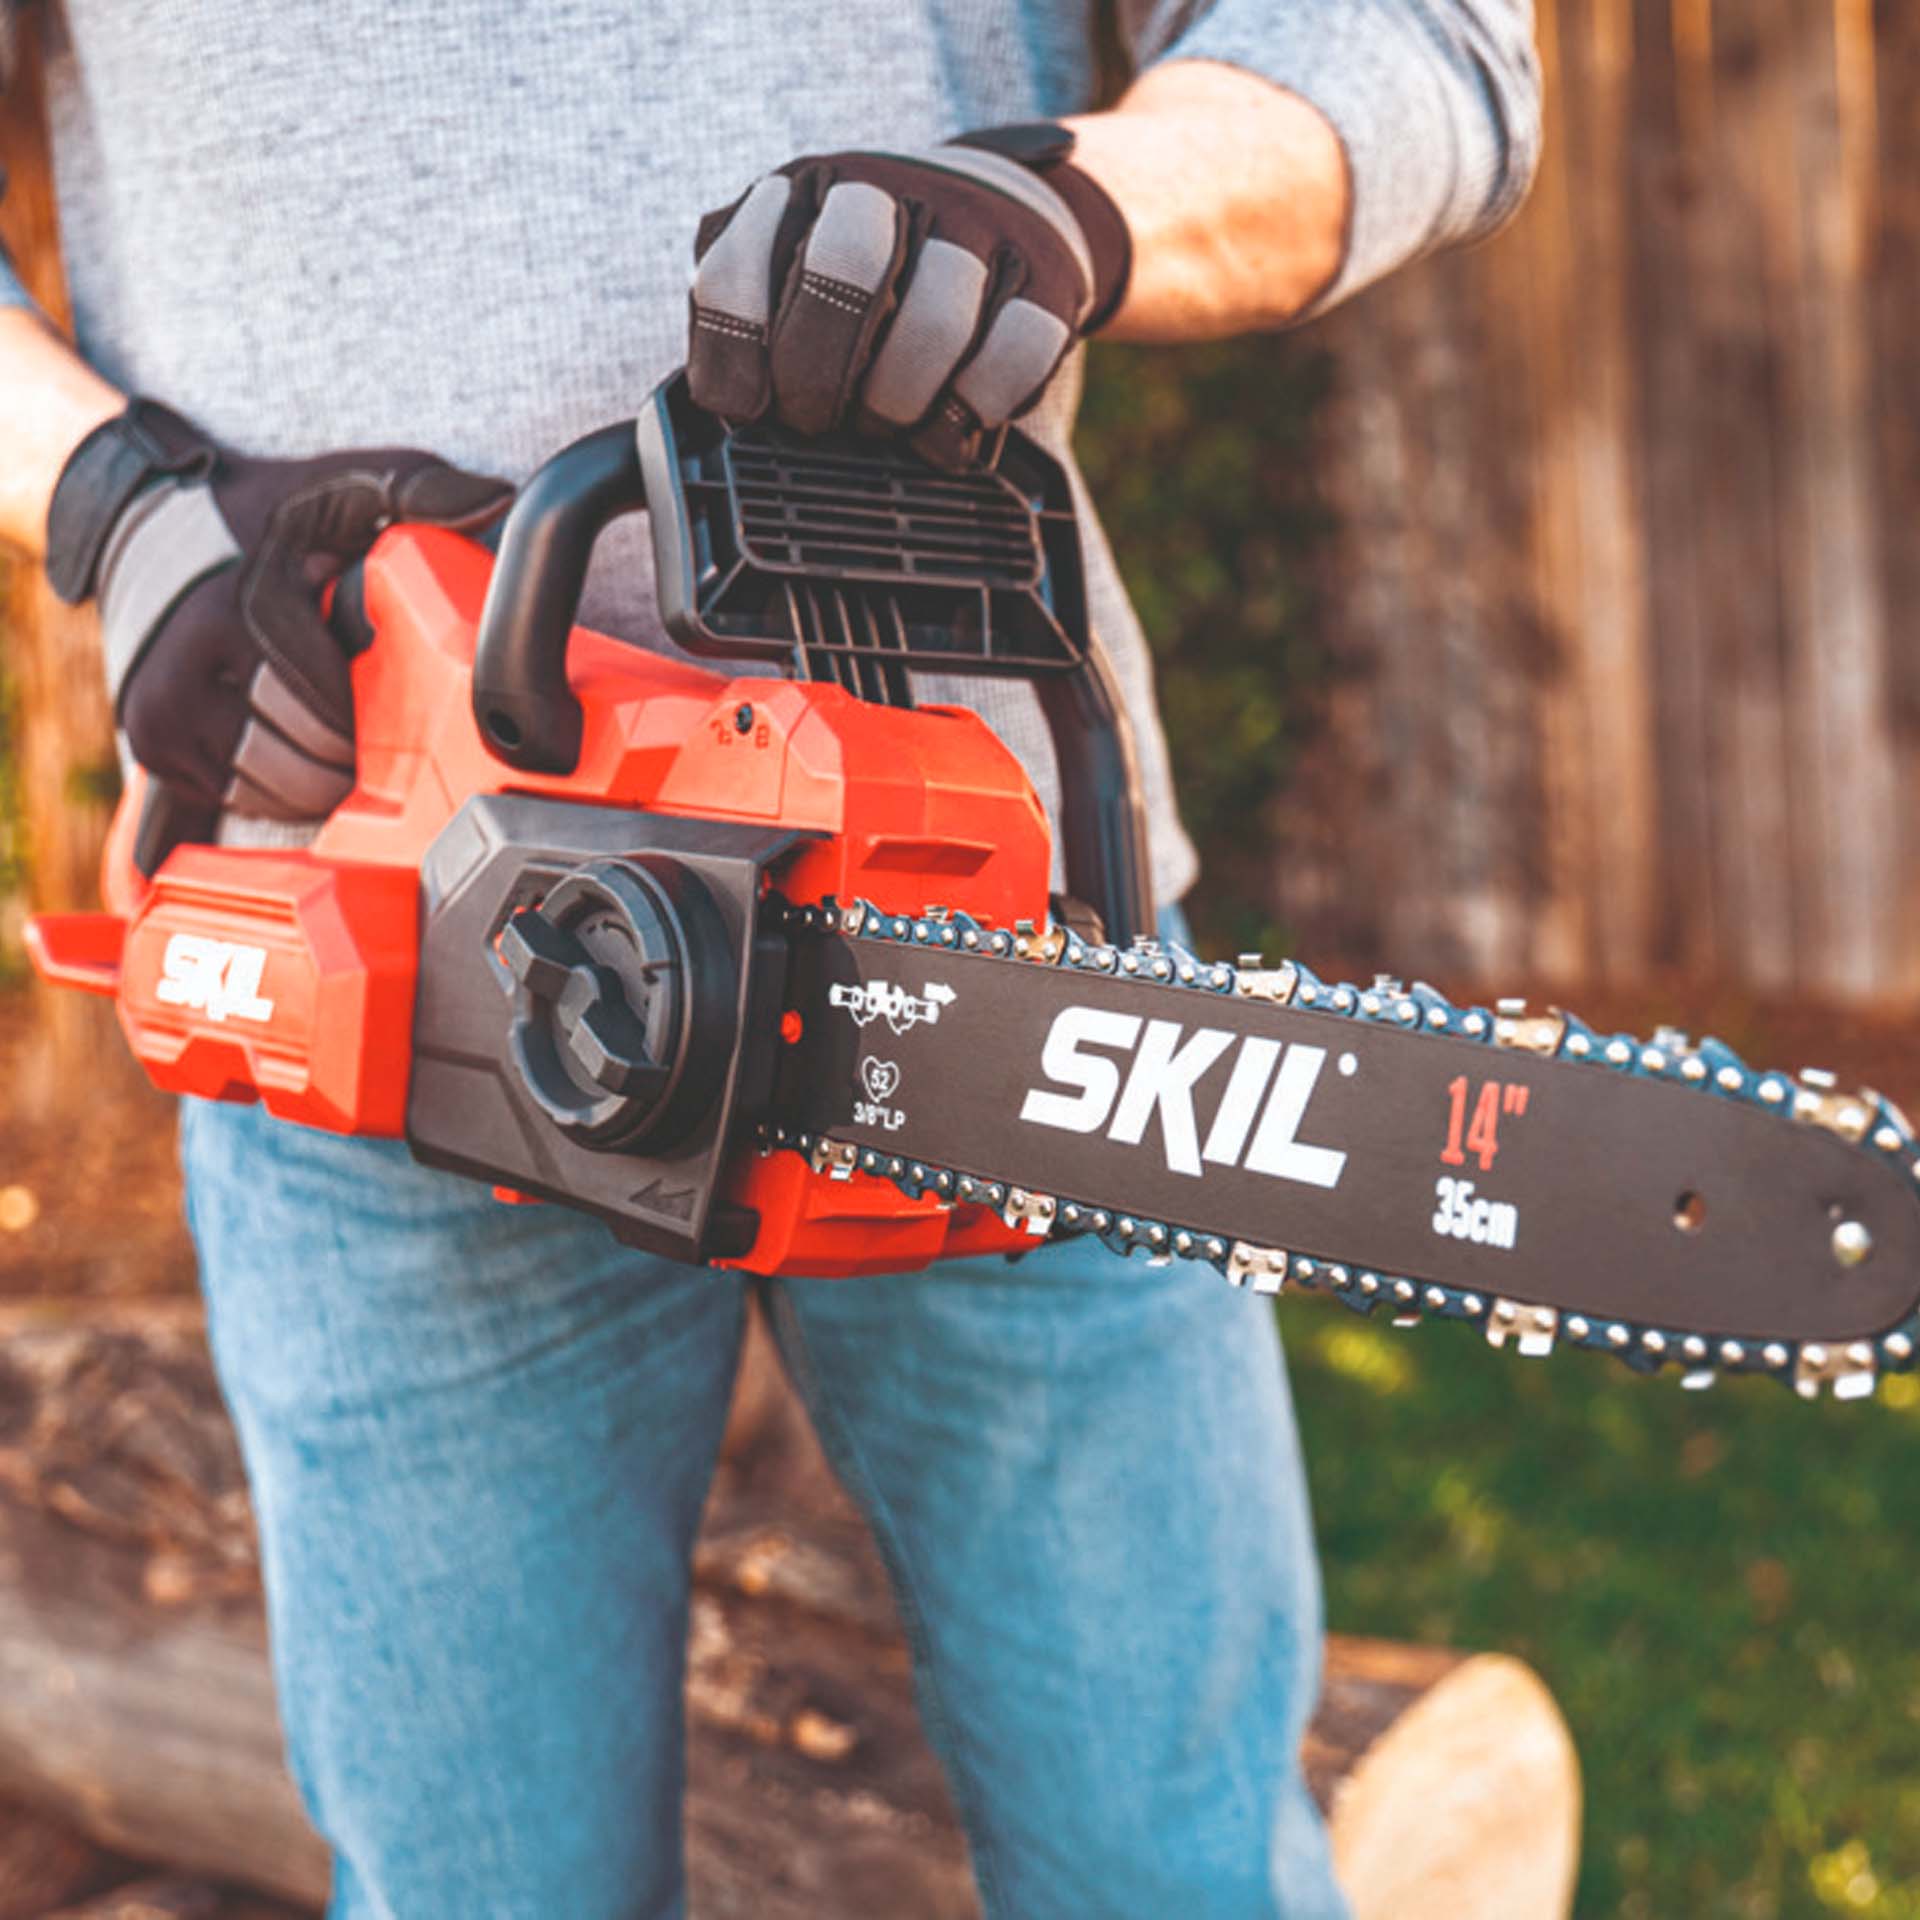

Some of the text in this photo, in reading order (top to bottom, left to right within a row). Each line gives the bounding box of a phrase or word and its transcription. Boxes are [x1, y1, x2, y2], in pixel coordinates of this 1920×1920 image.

[156, 933, 274, 1022] SKIL
[870, 1069, 890, 1090] 52
[1019, 1006, 1347, 1188] SKIL
[1440, 1075, 1529, 1171] 14"
[1432, 1176, 1518, 1249] 35cm
